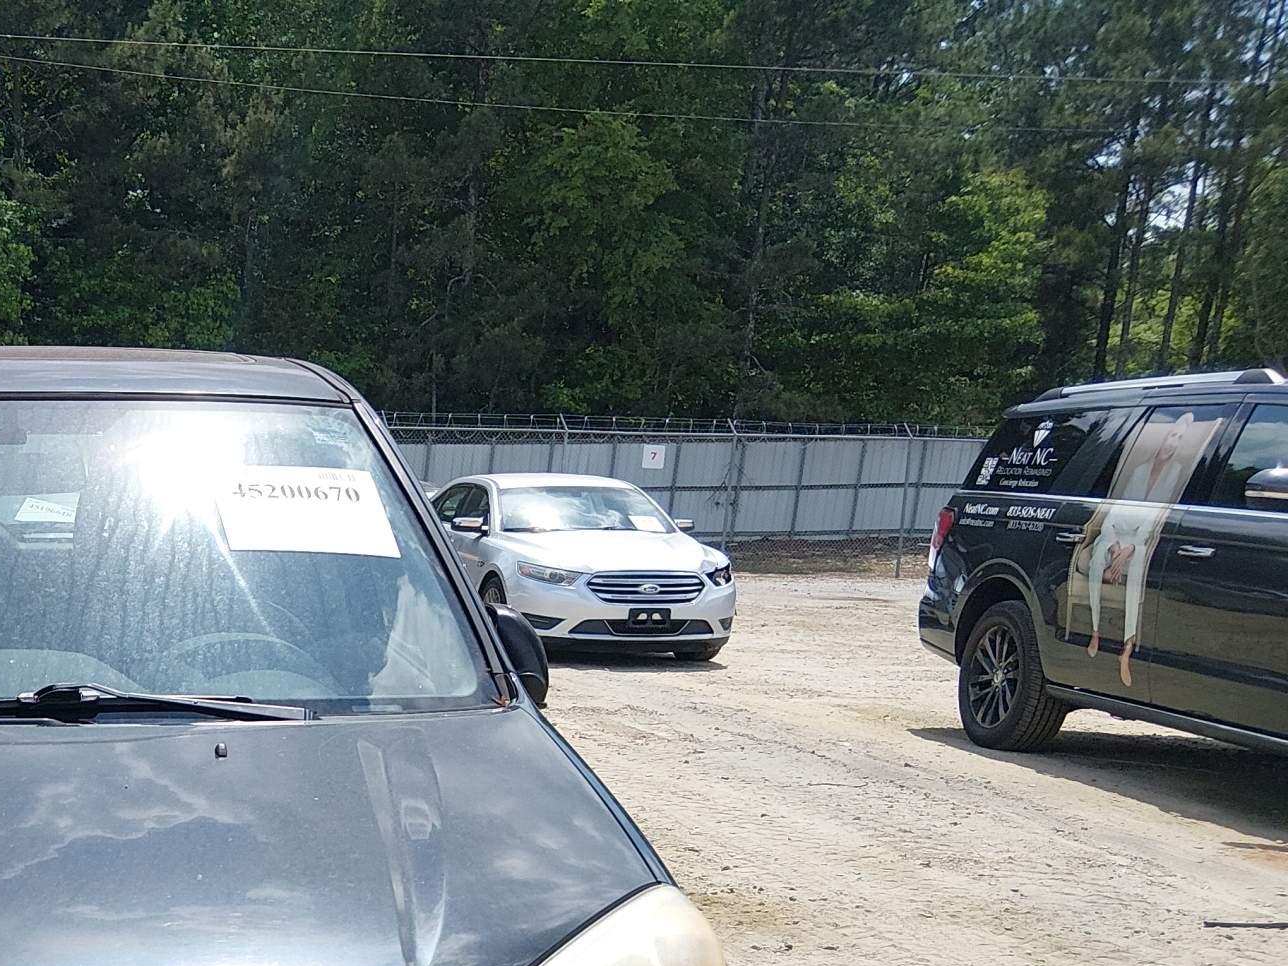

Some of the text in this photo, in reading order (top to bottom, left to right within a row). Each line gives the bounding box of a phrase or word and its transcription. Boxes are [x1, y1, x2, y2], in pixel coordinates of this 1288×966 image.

[650, 451, 657, 461] 7
[1031, 447, 1054, 466] NC
[232, 483, 360, 502] 45200670
[964, 504, 999, 515] NeatNC.com
[1006, 506, 1056, 519] 833-SOS-NEAT
